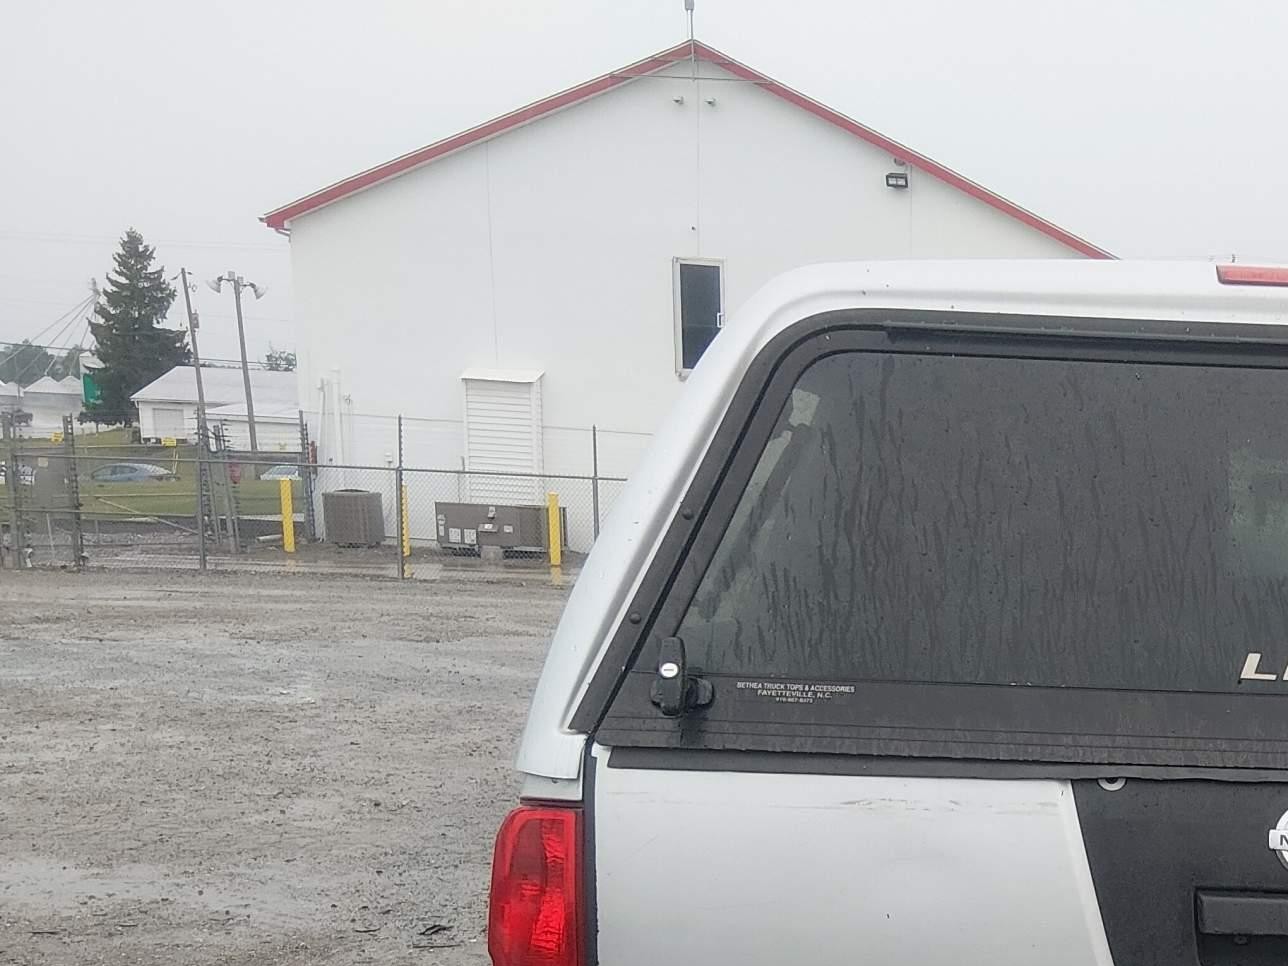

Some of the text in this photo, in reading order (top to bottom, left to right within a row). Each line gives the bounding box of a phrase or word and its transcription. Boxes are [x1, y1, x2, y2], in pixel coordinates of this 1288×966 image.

[764, 682, 785, 690] TRUCK
[786, 683, 804, 691] TOPS
[810, 685, 855, 693] ACCESSORIES
